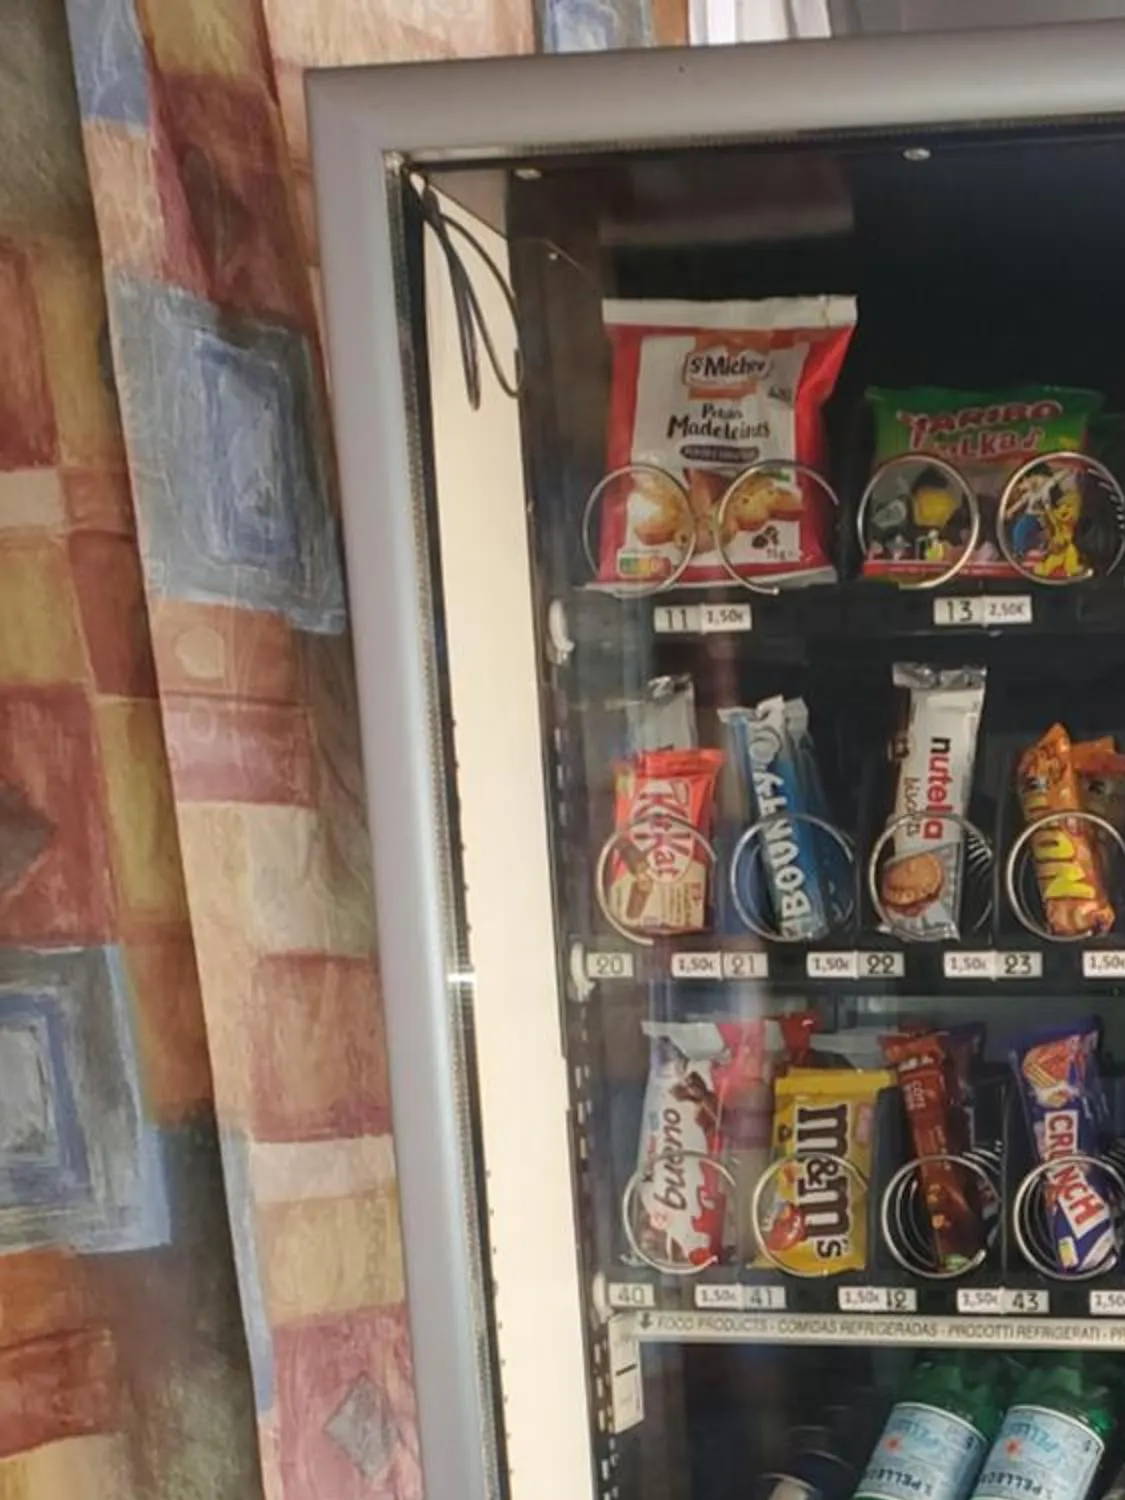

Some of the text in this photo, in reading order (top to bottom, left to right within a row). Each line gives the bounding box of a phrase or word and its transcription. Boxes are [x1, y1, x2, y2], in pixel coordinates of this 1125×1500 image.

[666, 609, 689, 630] 11
[946, 600, 973, 622] 13
[923, 736, 952, 841] nutella
[1024, 795, 1096, 899] LON
[596, 954, 625, 975] 20
[731, 955, 755, 975] 21
[866, 954, 895, 975] 22
[1004, 954, 1031, 975] 23
[654, 1108, 687, 1211] bueno
[797, 1104, 851, 1259] m&m's
[618, 1287, 644, 1305] 40
[749, 1287, 773, 1305] 41
[1012, 1292, 1040, 1311] 43
